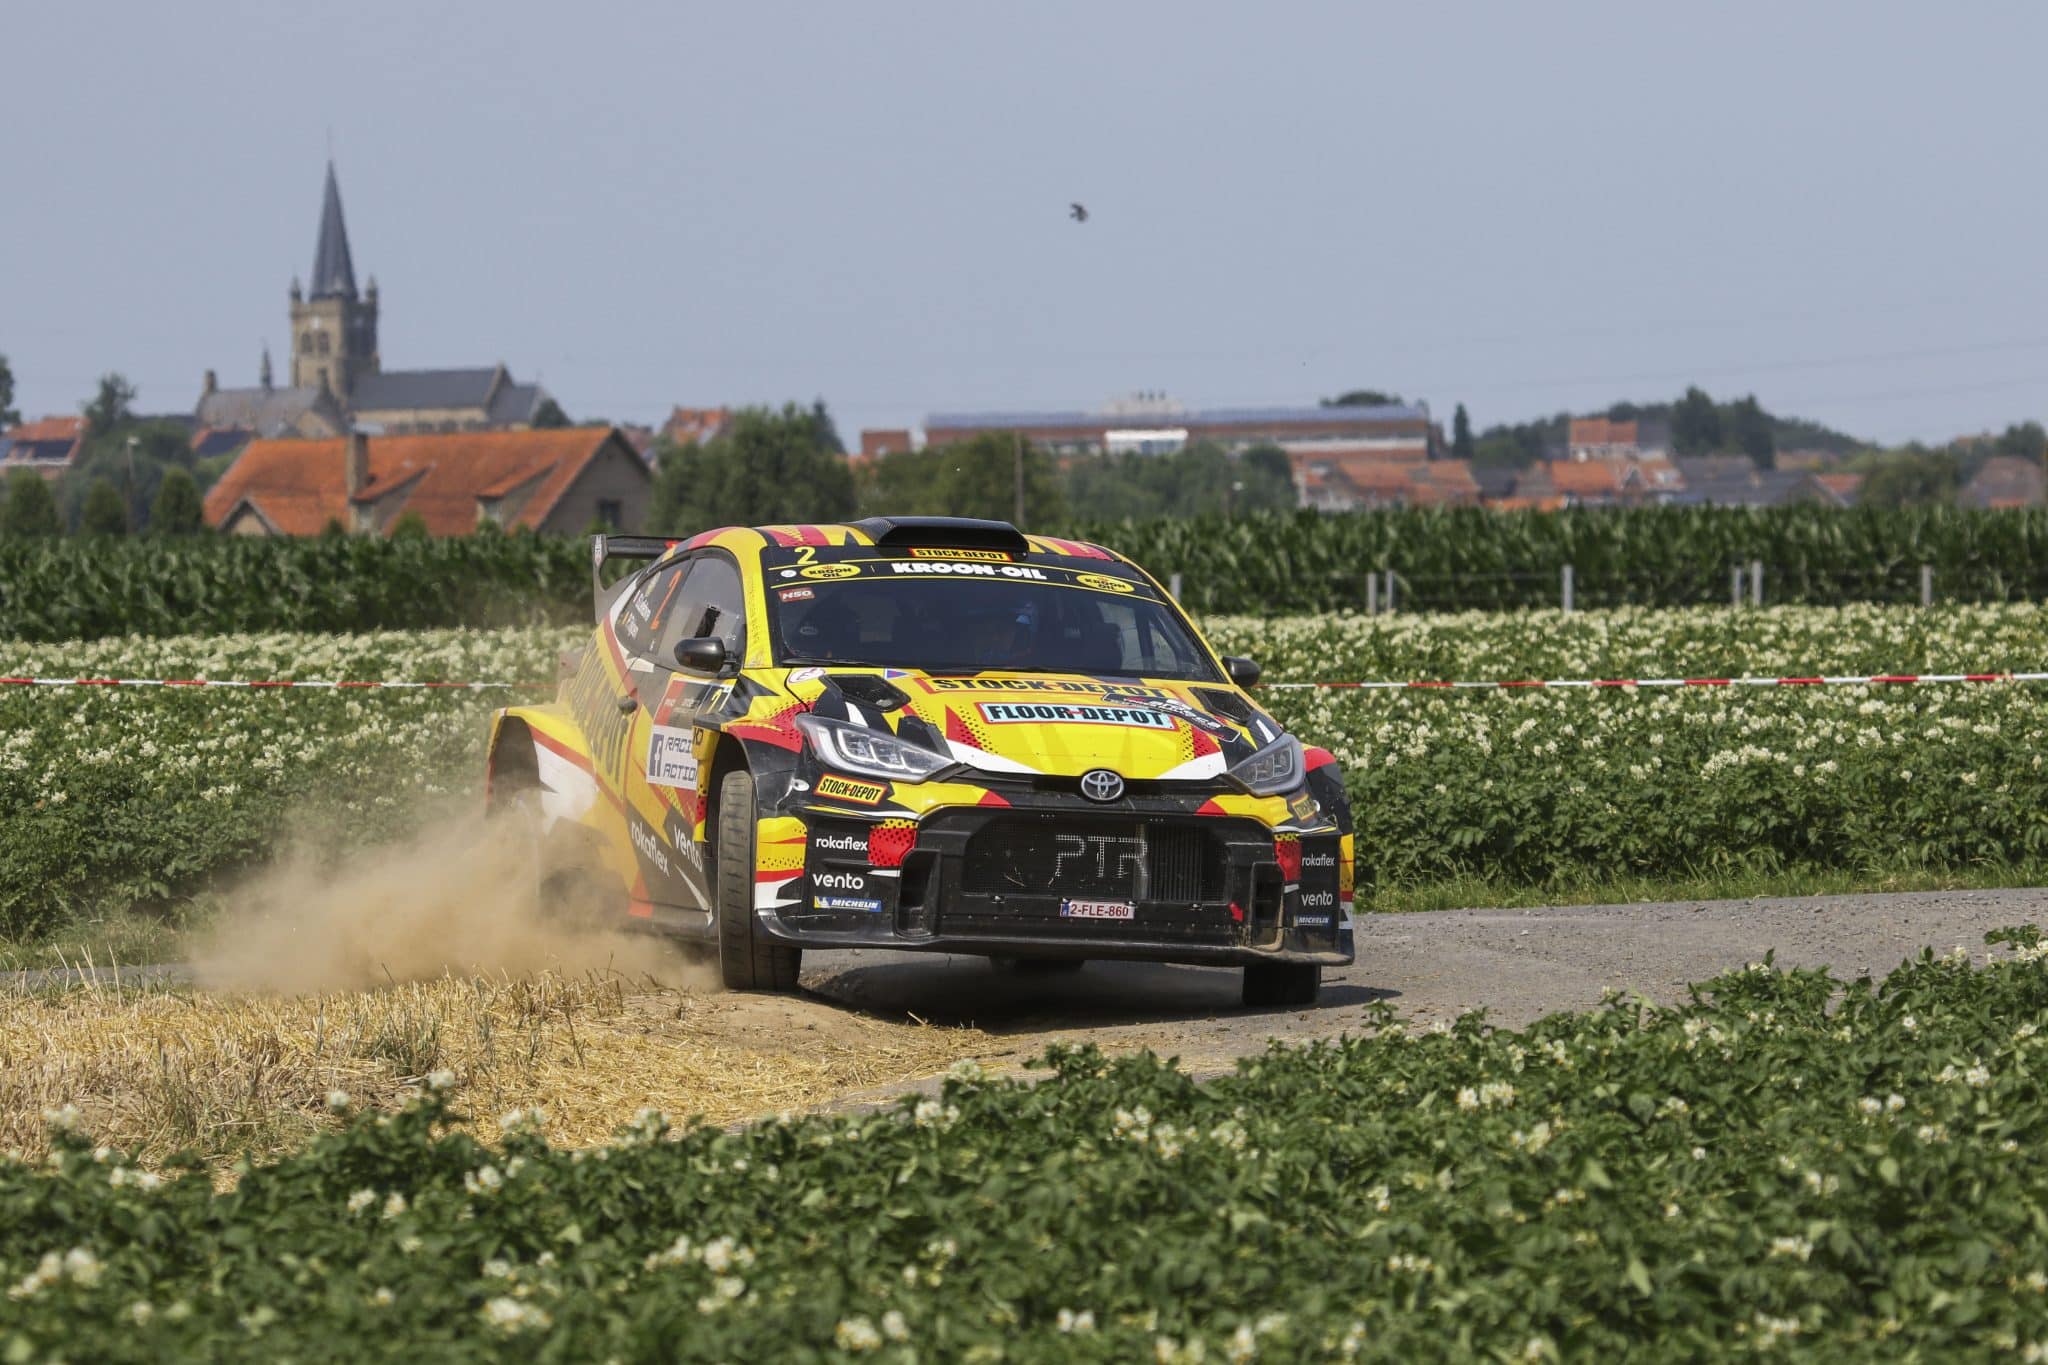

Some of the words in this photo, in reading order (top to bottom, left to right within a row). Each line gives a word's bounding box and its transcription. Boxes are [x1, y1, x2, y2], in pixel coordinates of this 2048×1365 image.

[795, 546, 818, 565] 2
[916, 549, 1006, 560] STOCK-DEPOT
[808, 567, 852, 575] KROON
[891, 563, 1047, 580] KROON-OIL
[1084, 578, 1126, 588] KROON
[936, 678, 1162, 698] STOCK-DEPOT
[991, 706, 1162, 725] FLOOR-DEPOT
[820, 778, 881, 801] STOCK-DEPOT
[630, 820, 670, 878] rokaflex
[674, 824, 703, 873] vento
[815, 836, 868, 851] rokaflex
[1056, 834, 1148, 878] PTR
[1301, 853, 1335, 867] rokaflex
[812, 873, 864, 890] vento
[830, 899, 878, 909] MICHELIN
[1301, 890, 1333, 906] vento
[1070, 904, 1129, 917] 2-FLE-860
[1298, 916, 1329, 924] MICHELIN
